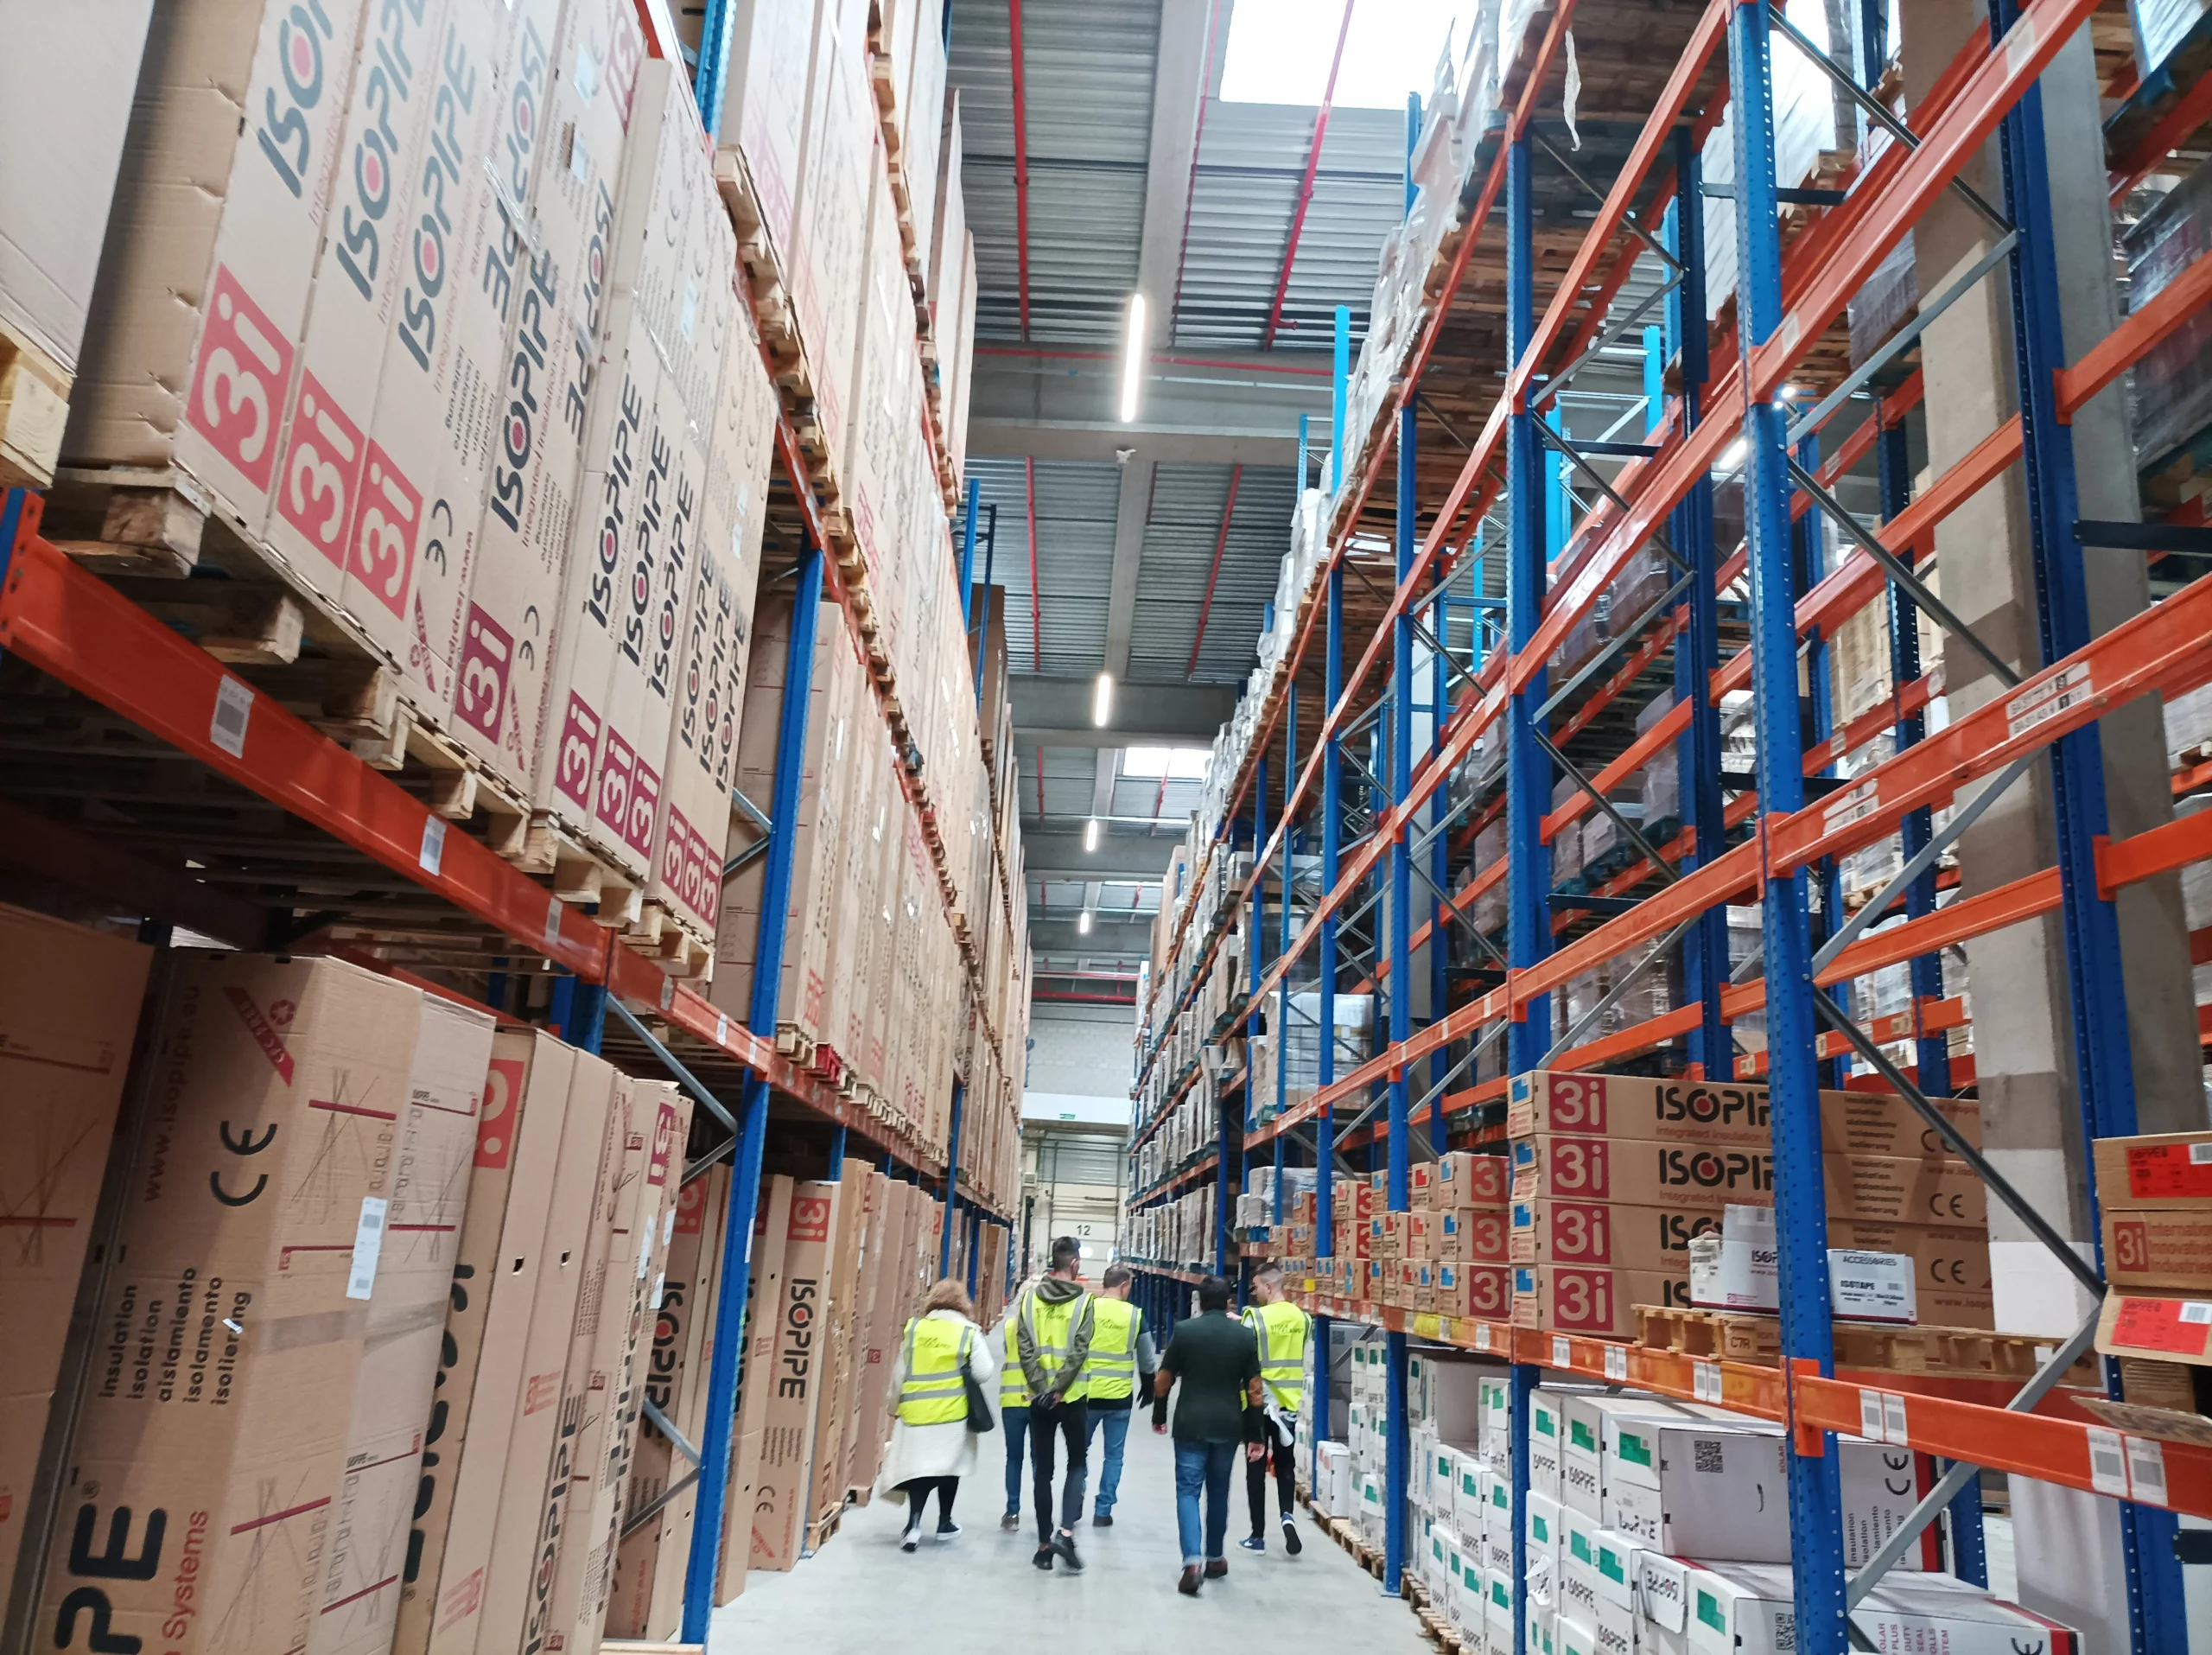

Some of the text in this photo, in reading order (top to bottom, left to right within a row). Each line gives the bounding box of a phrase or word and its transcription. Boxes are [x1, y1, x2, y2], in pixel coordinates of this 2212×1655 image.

[398, 22, 476, 373] ISOPIPE
[484, 15, 547, 328] ISOPPE
[566, 178, 614, 448] ISOPPE
[201, 291, 283, 463] 3i
[491, 248, 556, 534] ISOPIPE
[290, 392, 355, 544] 3i
[588, 372, 642, 628] ISOPIPE
[360, 462, 414, 599] 3i
[621, 424, 671, 667] ISOPIPE
[651, 471, 694, 699] ISOPIPE
[462, 620, 508, 727] 3i
[682, 546, 715, 749] ISOPIPE
[700, 577, 733, 774] ISOPIPE
[563, 703, 597, 795] 3i
[715, 608, 747, 793] ISOPIPE
[602, 739, 632, 824] 3i
[632, 768, 658, 848] 3i
[665, 814, 686, 888] 3i
[684, 837, 704, 906] 3i
[702, 857, 720, 920] 3i
[1554, 1080, 1599, 1126] 3i
[1656, 1085, 1770, 1127] ISOPIP
[1555, 1144, 1776, 1191] 3i ISOPIP
[792, 1200, 826, 1238] 3i
[1077, 1225, 1091, 1236] 12
[1476, 1218, 1510, 1255] 3
[1555, 1209, 1603, 1256] 3i
[1842, 1256, 1897, 1267] ACCESSORIES
[2117, 1227, 2145, 1266] 3i
[156, 1267, 197, 1403] aislamiento
[182, 1276, 224, 1404] isolamento
[779, 1278, 818, 1399] ISOPIPE
[1558, 1275, 1606, 1324] 3i
[162, 1510, 209, 1640] Systems
[1890, 1624, 1899, 1651] PLUS
[1903, 1625, 1911, 1652] DUTY
[1916, 1627, 1924, 1652] SEAL
